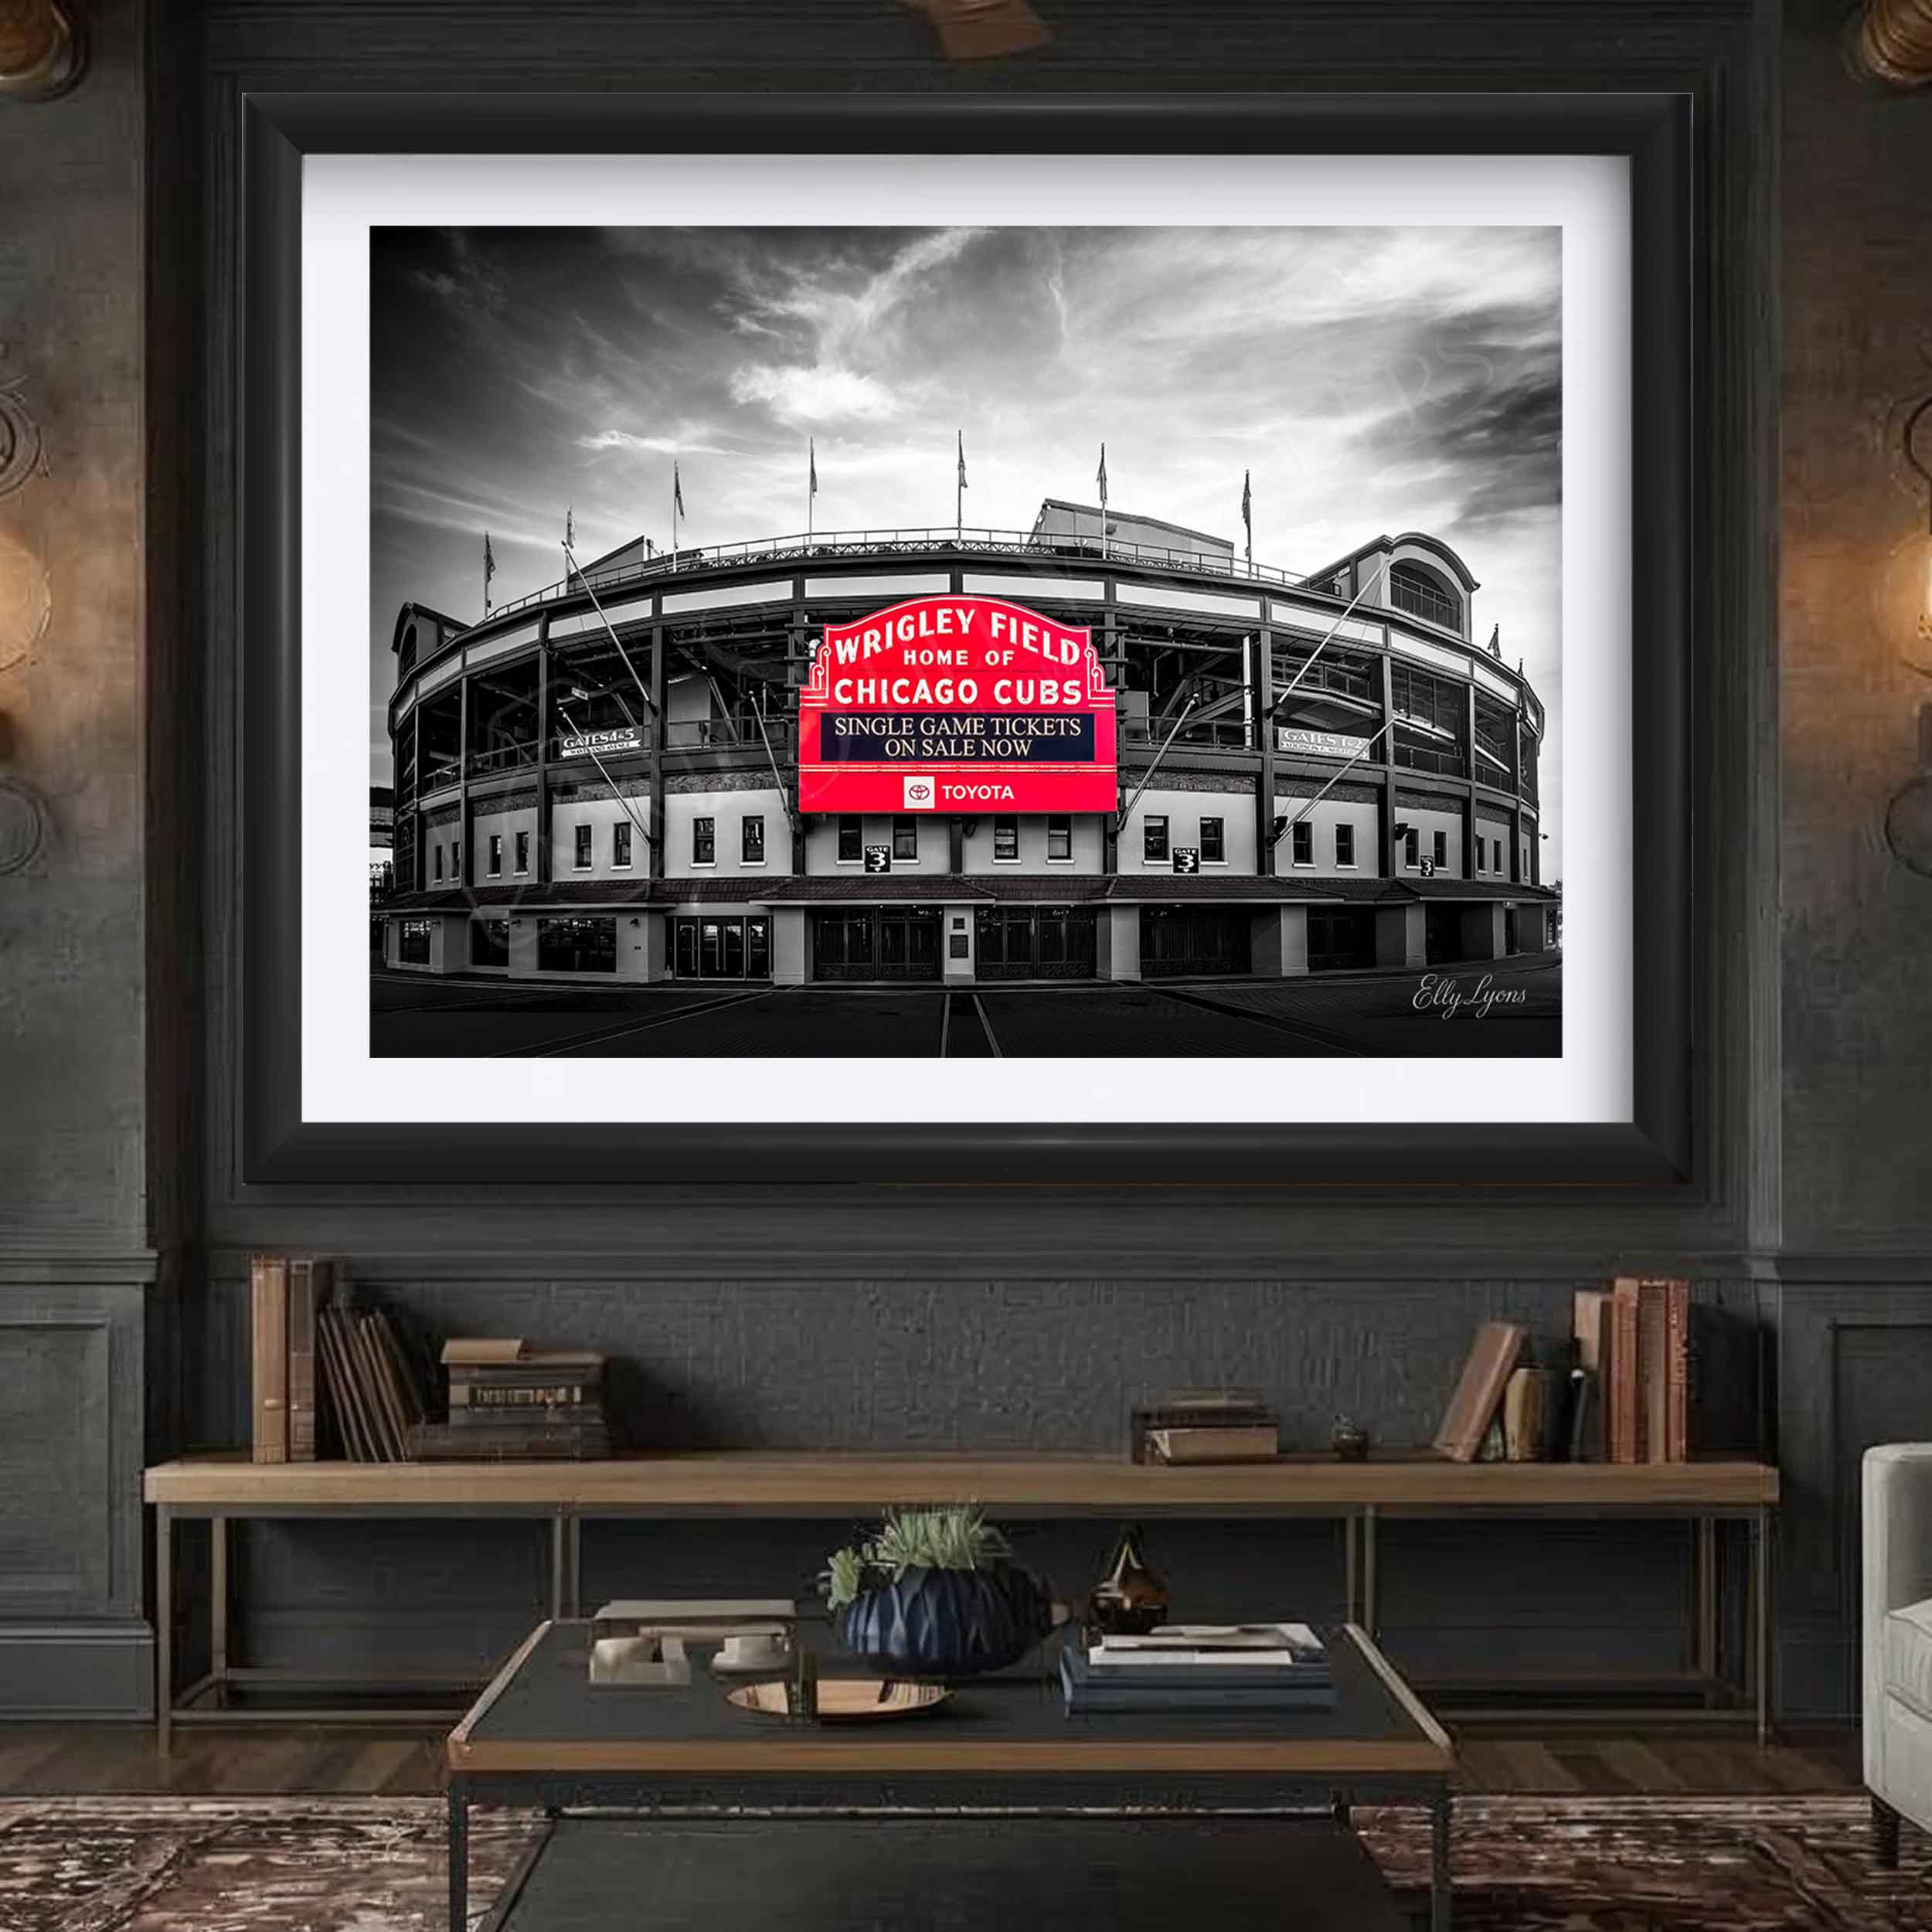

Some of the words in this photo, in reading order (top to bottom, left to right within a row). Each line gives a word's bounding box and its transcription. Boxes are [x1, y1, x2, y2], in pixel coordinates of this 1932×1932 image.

[835, 608, 975, 665] WRIGLEY
[991, 611, 1080, 665] FIELD
[903, 650, 968, 665] HOME
[985, 650, 1014, 665] OF
[835, 679, 978, 705] CHICAGO
[994, 679, 1081, 706] CUBS
[835, 717, 914, 736] SINGLE
[920, 717, 985, 736] GAME
[990, 717, 1081, 736] TICKETS
[885, 739, 916, 757] ON
[923, 739, 975, 757] SALE
[981, 739, 1032, 757] NOW
[941, 785, 1015, 800] TOYOTA
[869, 852, 886, 867] 3
[1178, 854, 1195, 869] 3
[1423, 860, 1432, 872] 3
[1413, 974, 1461, 1019] Elly
[1463, 974, 1526, 1019] Lyons
